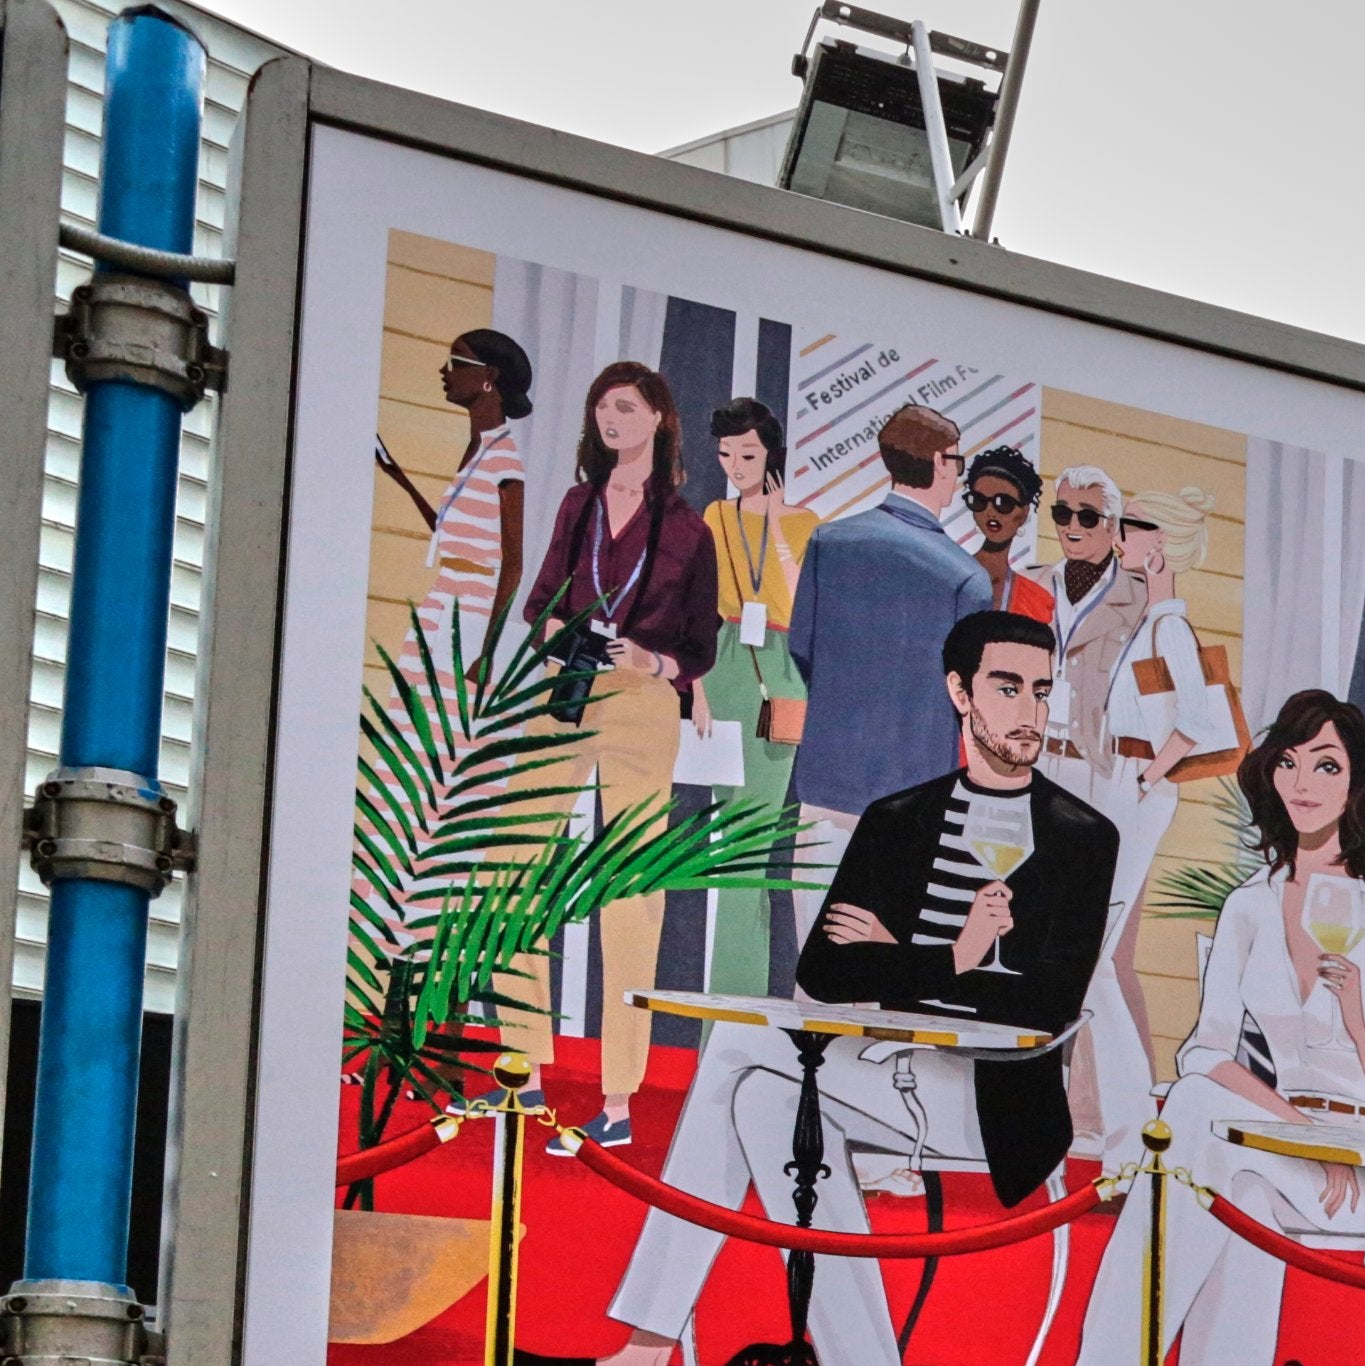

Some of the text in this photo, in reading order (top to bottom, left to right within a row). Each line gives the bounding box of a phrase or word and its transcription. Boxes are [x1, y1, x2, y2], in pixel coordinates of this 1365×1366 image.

[805, 348, 900, 411] Festival de
[809, 393, 918, 471] Internatiol
[917, 375, 958, 404] Film
